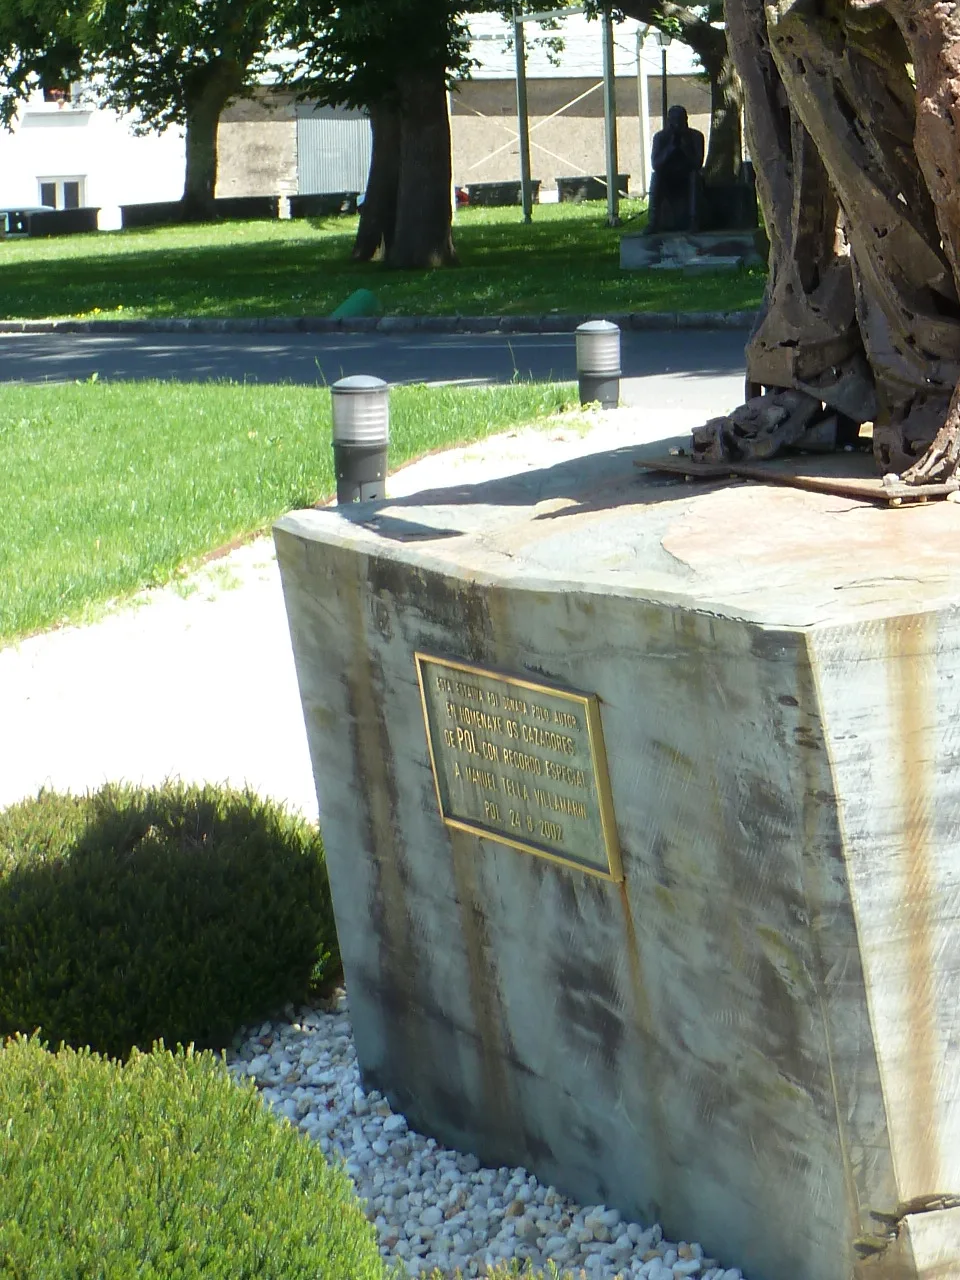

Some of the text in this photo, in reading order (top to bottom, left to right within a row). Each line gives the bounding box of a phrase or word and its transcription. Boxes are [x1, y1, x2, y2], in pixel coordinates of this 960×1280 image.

[445, 701, 457, 718] EN
[460, 706, 503, 734] HOMENAXE
[506, 720, 519, 739] OS
[503, 696, 527, 713] DONADA
[531, 705, 550, 722] POLO
[444, 729, 456, 748] DE
[482, 741, 499, 762] CON
[503, 748, 541, 776] RECORDO
[545, 761, 586, 789] ESPECIAL
[454, 763, 461, 779] A
[465, 767, 496, 792] MANUEL
[501, 777, 529, 801] TELLA
